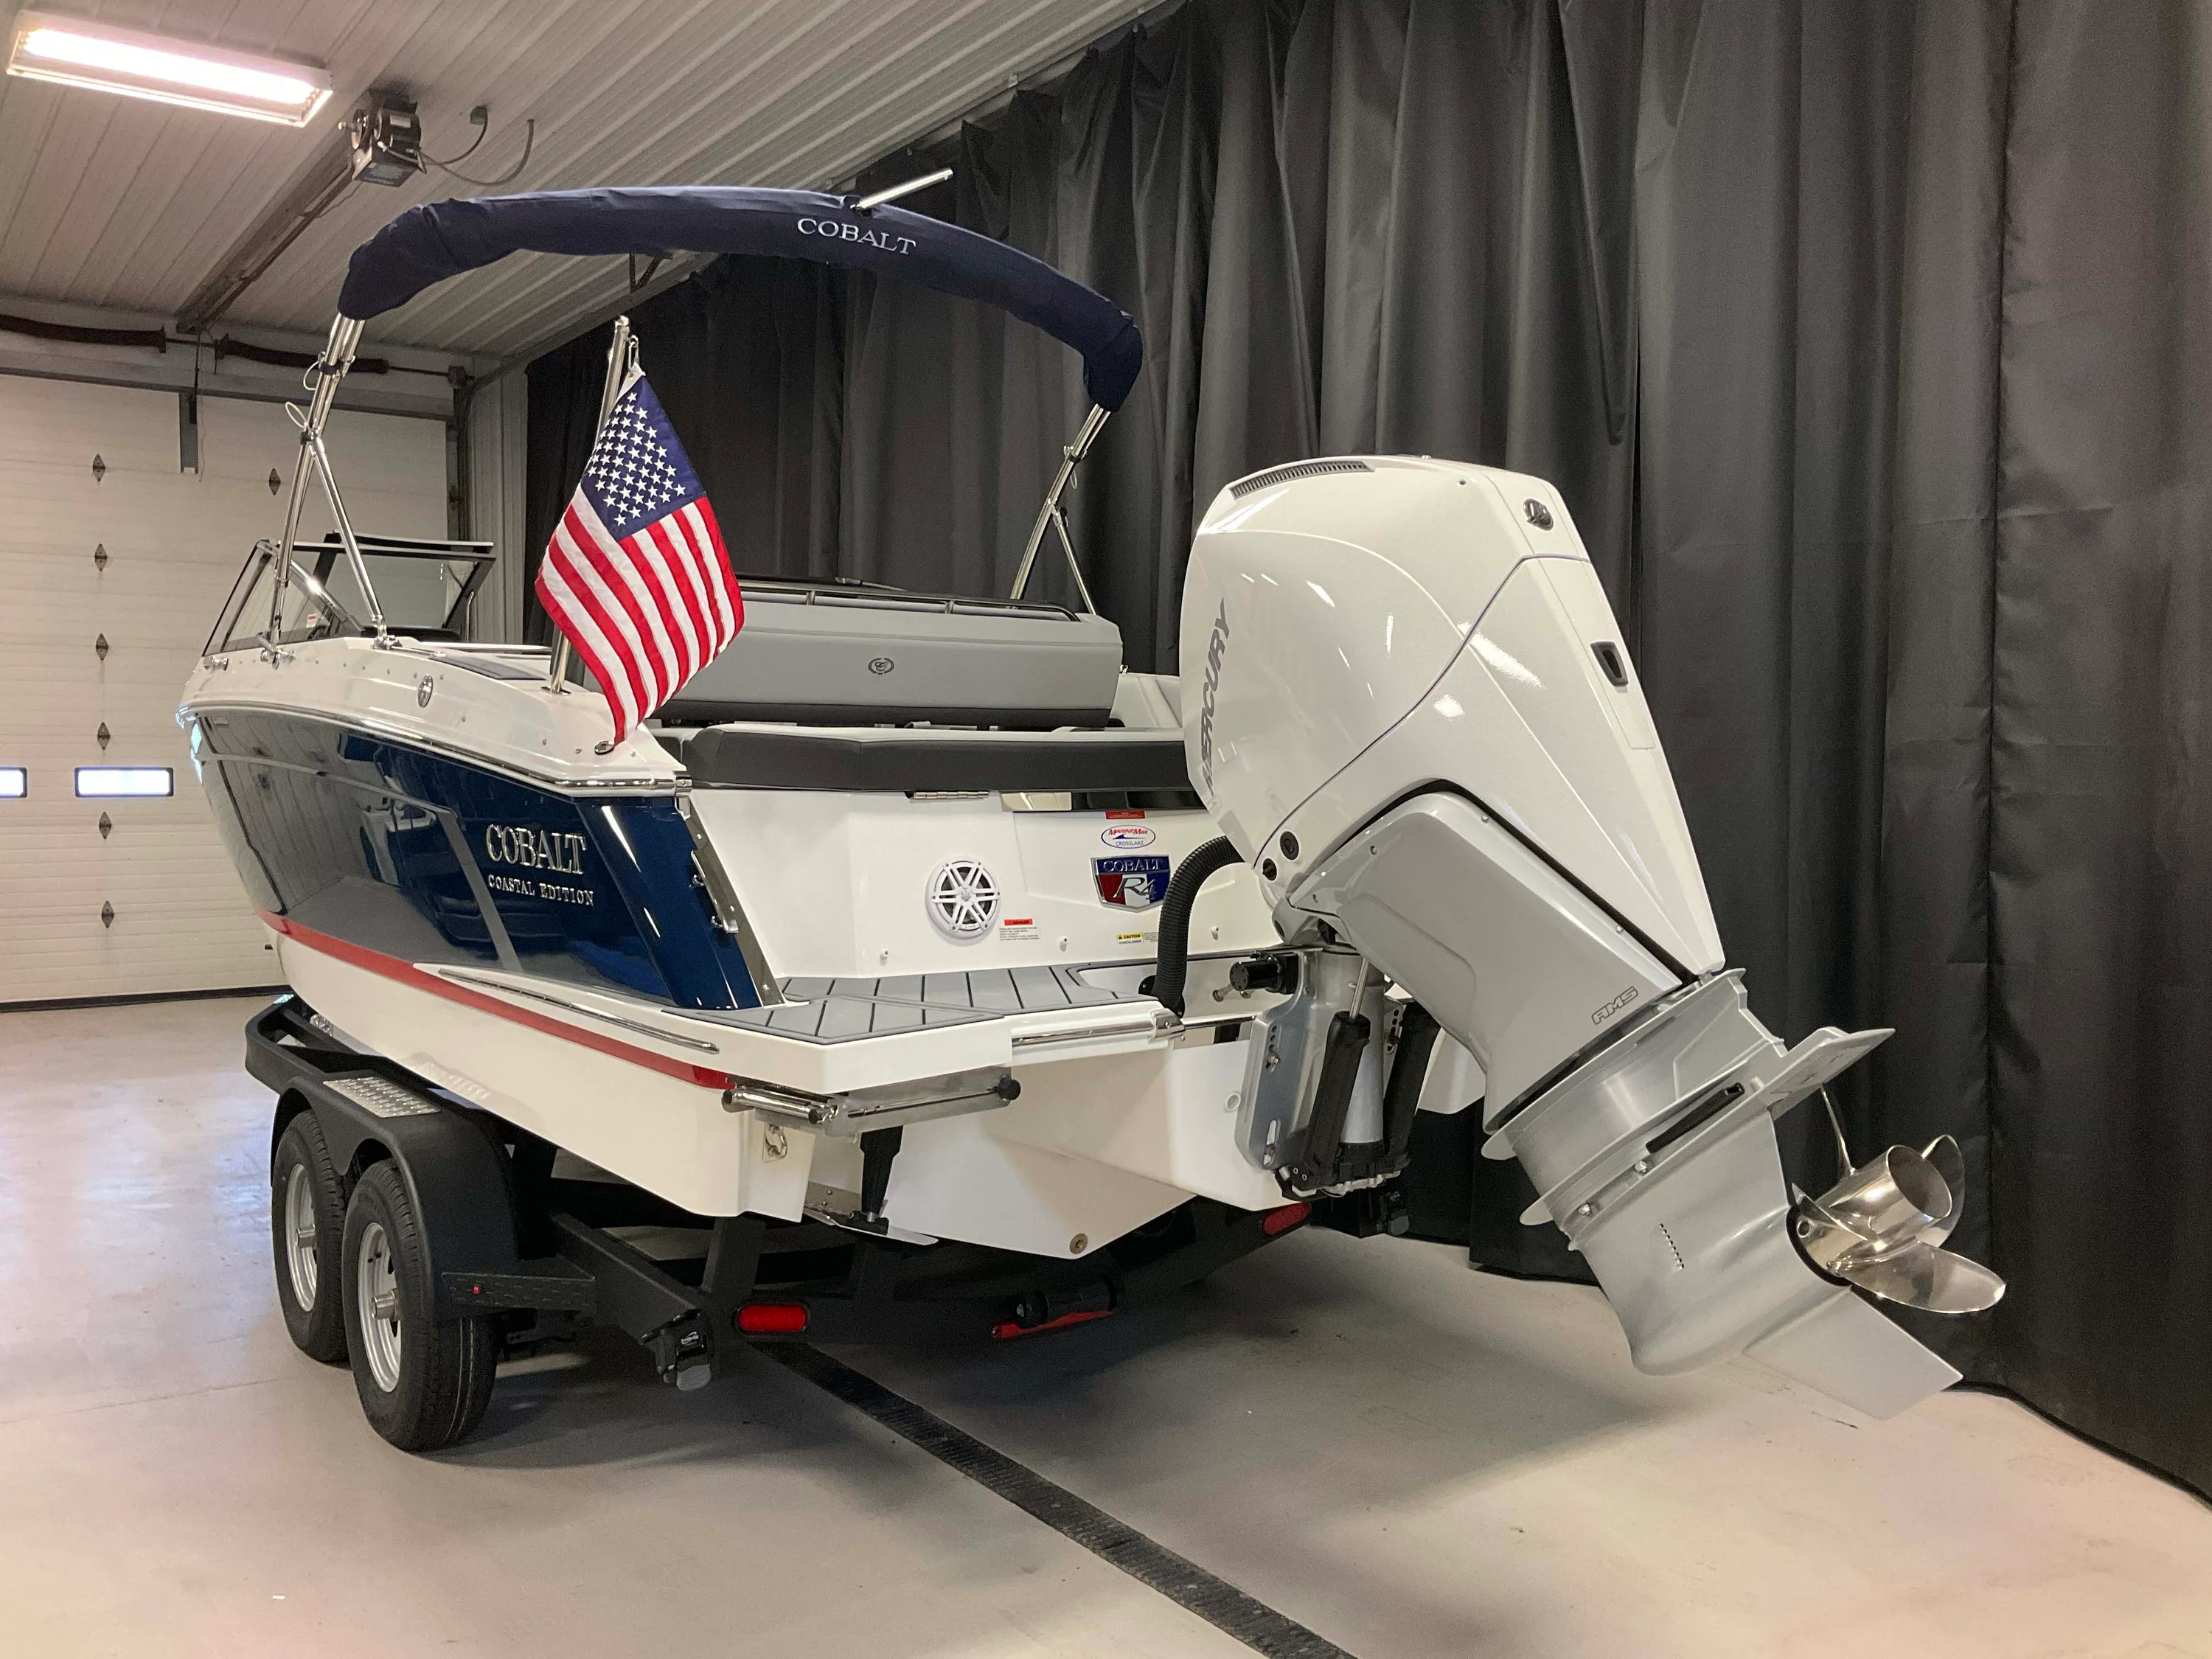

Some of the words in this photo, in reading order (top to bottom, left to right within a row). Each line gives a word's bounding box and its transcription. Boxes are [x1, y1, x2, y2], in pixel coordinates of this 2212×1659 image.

[797, 218, 917, 255] COBALT
[485, 824, 587, 875] COBALT
[1103, 858, 1161, 872] COBALT
[487, 874, 535, 896] COASTAL
[538, 882, 594, 907] EDITION
[1113, 877, 1157, 900] R4
[1591, 986, 1639, 1026] AMS
